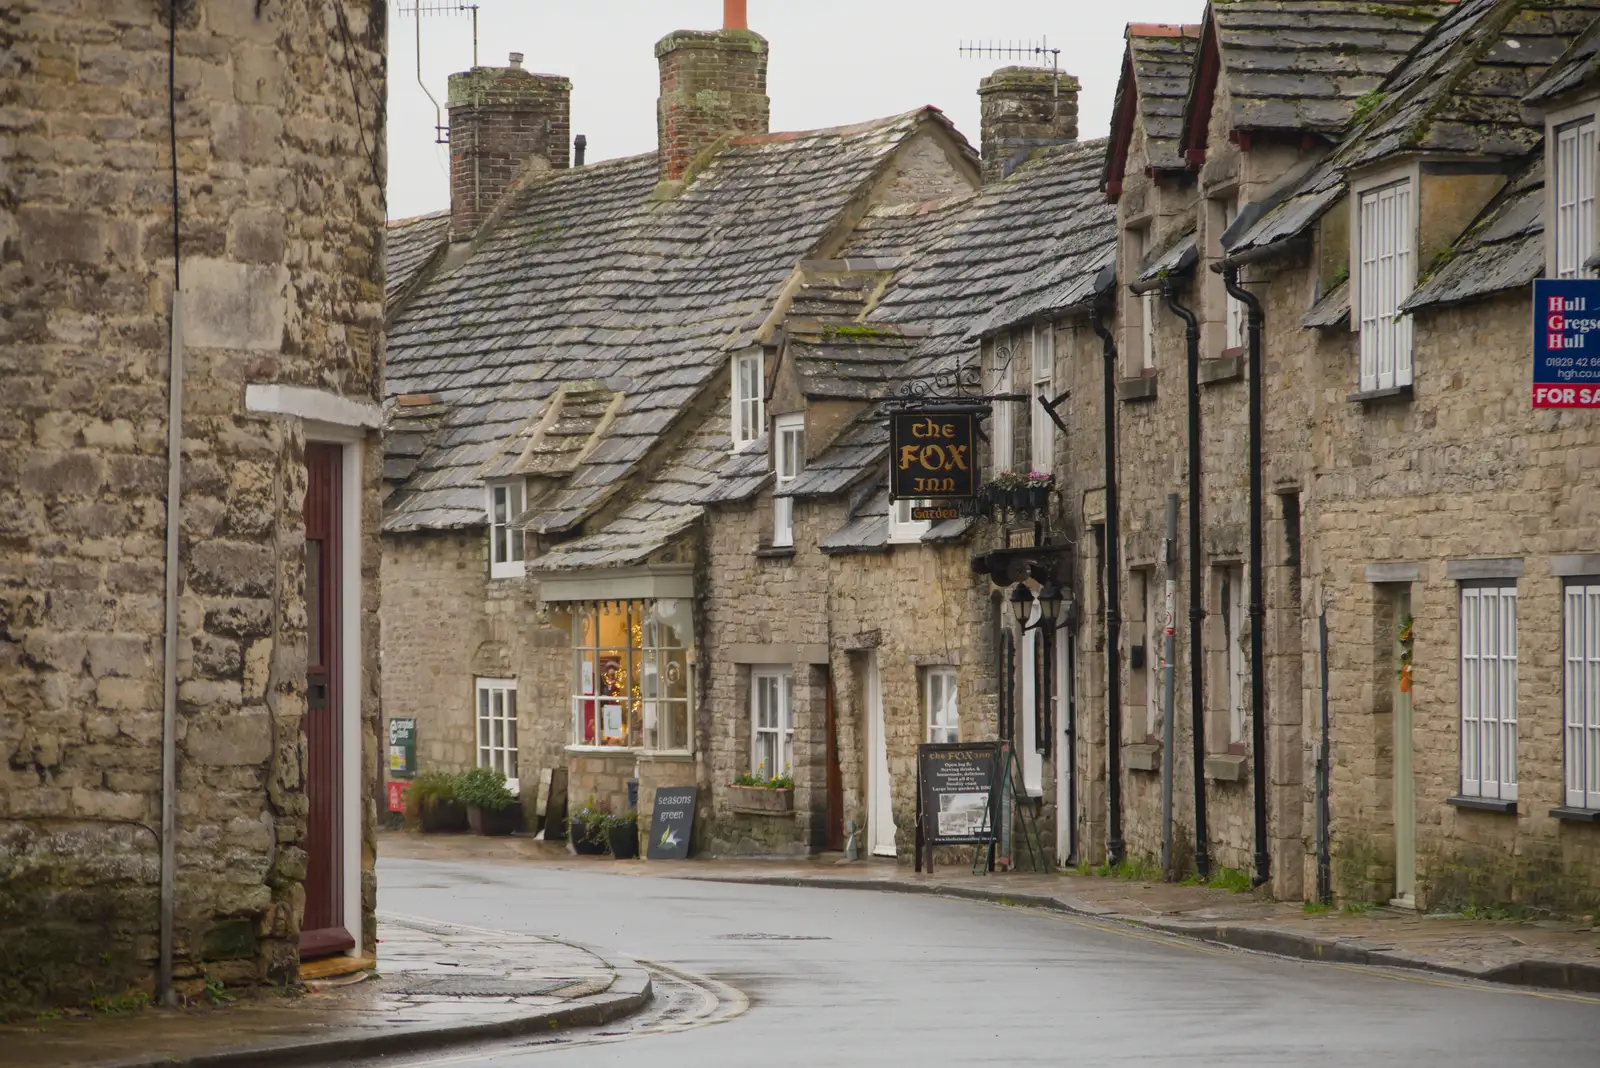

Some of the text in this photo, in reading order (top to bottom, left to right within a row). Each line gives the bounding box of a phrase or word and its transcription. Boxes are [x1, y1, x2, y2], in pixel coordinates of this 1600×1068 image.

[1549, 297, 1586, 311] Hull
[1548, 334, 1585, 348] Hull
[1546, 357, 1573, 367] 01929
[1575, 357, 1588, 367] 42
[1536, 388, 1576, 404] FOR
[899, 444, 969, 471] FOX
[912, 507, 957, 519] Garden
[948, 751, 973, 761] FOX
[658, 795, 691, 805] seasons
[660, 810, 684, 822] green
